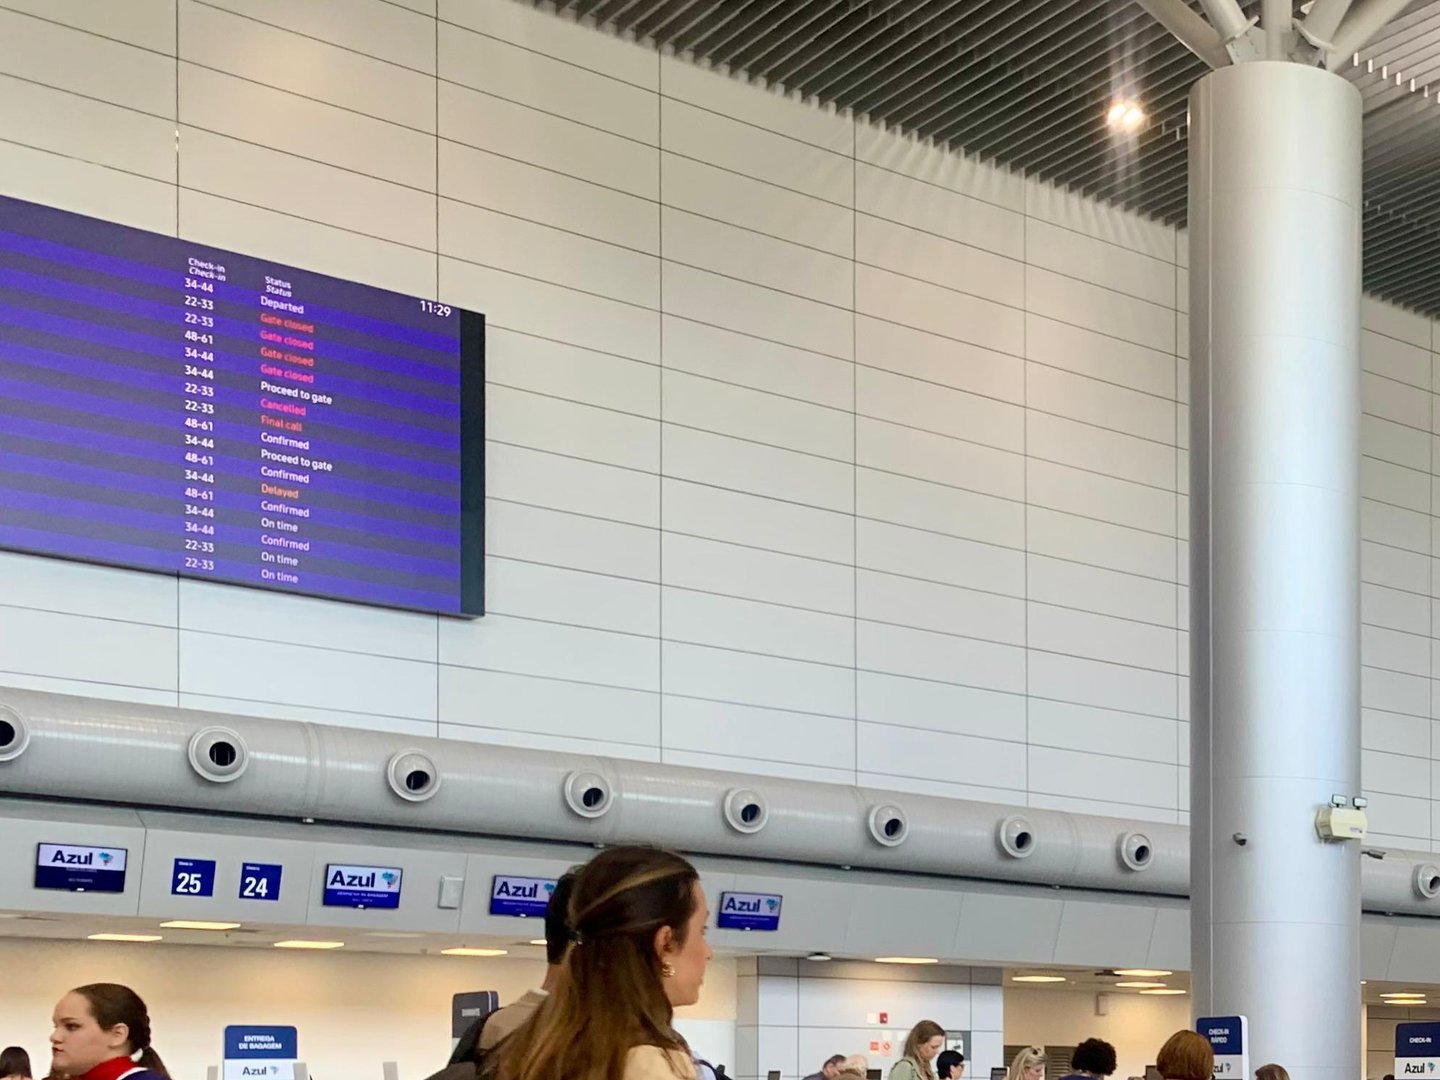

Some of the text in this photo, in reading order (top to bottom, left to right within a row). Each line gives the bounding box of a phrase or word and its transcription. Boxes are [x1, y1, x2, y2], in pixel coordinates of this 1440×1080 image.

[188, 257, 226, 273] Check-in
[189, 266, 226, 282] Check-in
[185, 278, 214, 293] 34-44
[265, 276, 292, 289] Status
[265, 284, 292, 298] Status
[185, 295, 214, 310] 22-33
[260, 296, 304, 314] Departed
[420, 300, 452, 317] 11:29
[185, 313, 214, 328] 22-33
[260, 313, 314, 333] Gate closed
[185, 330, 213, 345] 48-61
[260, 330, 314, 350] Gate closed
[185, 347, 214, 362] 34-44
[260, 347, 314, 367] Gate closed
[185, 365, 214, 380] 34-44
[260, 364, 314, 384] Gate closed
[185, 383, 214, 397] 22-33
[261, 381, 333, 405] Proceed to gate
[185, 400, 214, 415] 22-33
[260, 398, 307, 416] Cancelled
[185, 418, 213, 432] 48-61
[261, 415, 303, 432] Final call
[185, 435, 214, 449] 34-44
[261, 432, 310, 450] Confirmed
[185, 452, 214, 466] 48-61
[261, 449, 333, 472] Proceed to gate
[185, 470, 214, 484] 34-44
[261, 466, 310, 484] Confirmed
[185, 487, 213, 501] 48-61
[261, 483, 299, 499] Delayed
[185, 504, 214, 518] 34-44
[261, 500, 310, 518] Confirmed
[185, 521, 214, 535] 34-44
[261, 517, 298, 533] On time
[185, 539, 214, 553] 22-33
[261, 534, 310, 551] Confirmed
[185, 557, 214, 571] 22-33
[261, 551, 298, 567] On time
[261, 569, 299, 584] On time
[51, 849, 93, 865] Azul
[176, 872, 202, 893] 25
[243, 876, 268, 897] 24
[330, 870, 376, 888] Azul
[496, 881, 538, 898] Azul
[725, 897, 761, 912] Azul
[242, 1066, 267, 1076] Azul
[1213, 1063, 1224, 1073] zul
[1404, 1062, 1425, 1074] Azul
